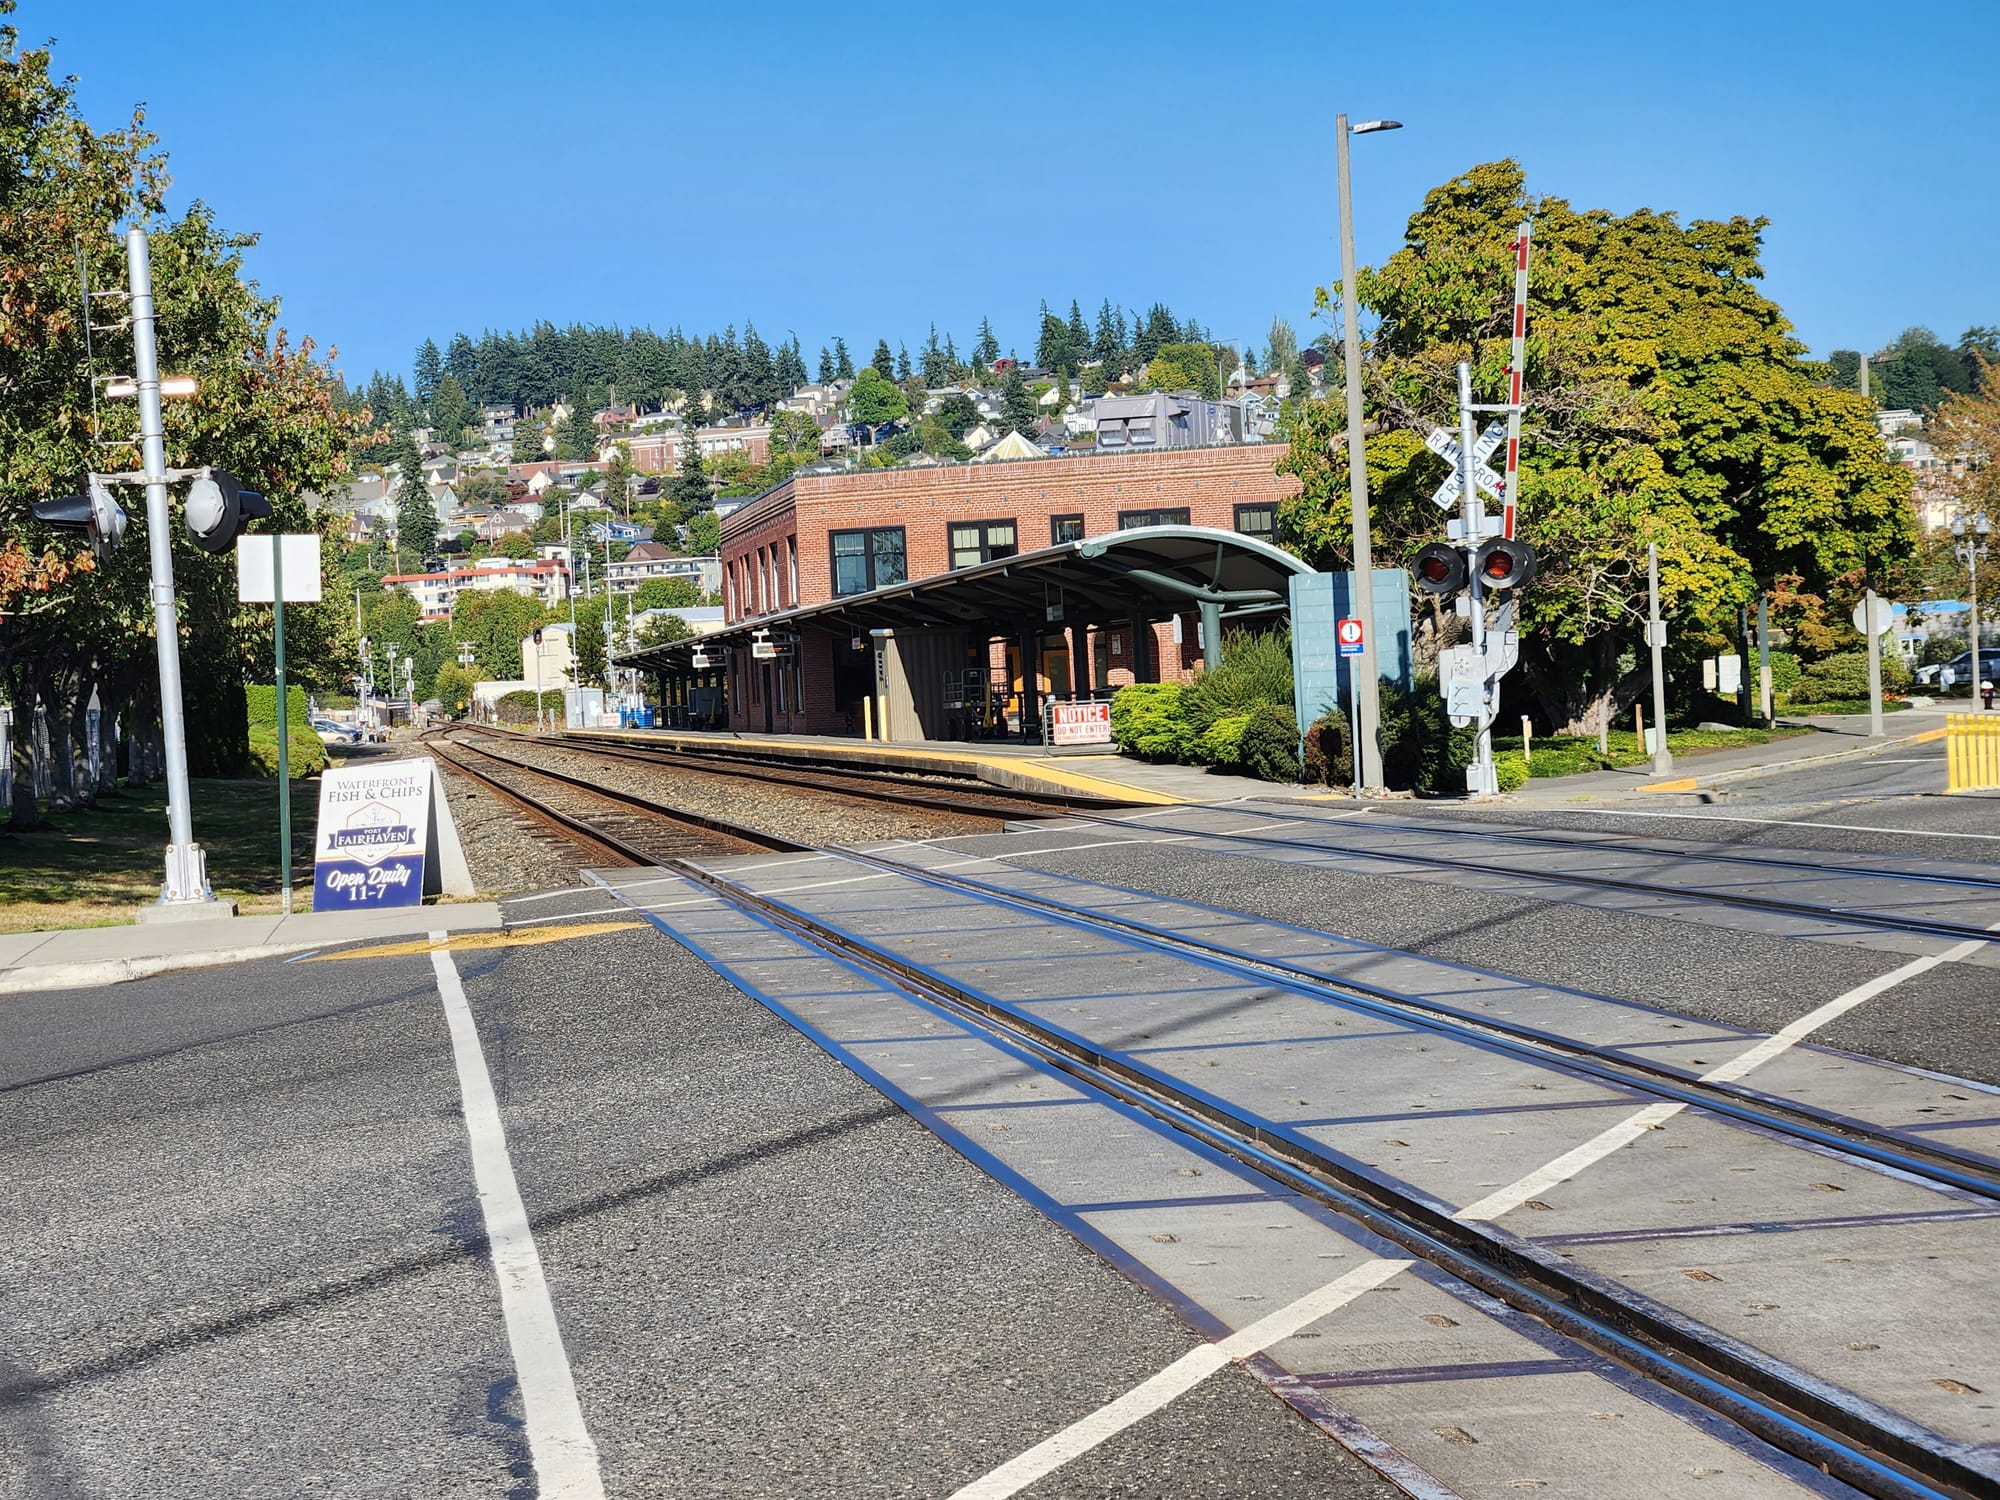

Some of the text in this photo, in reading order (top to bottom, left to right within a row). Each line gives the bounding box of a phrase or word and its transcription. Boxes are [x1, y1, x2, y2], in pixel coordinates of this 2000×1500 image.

[1059, 706, 1104, 723] NOTICE
[1057, 724, 1108, 735] DO NOT ENTER
[338, 777, 415, 789] WATERFRONT
[328, 785, 423, 803] FISH & CHIPS
[338, 827, 407, 846] FAIRHAVEN
[326, 863, 412, 892] Open Daily
[349, 883, 387, 901] 11-7
